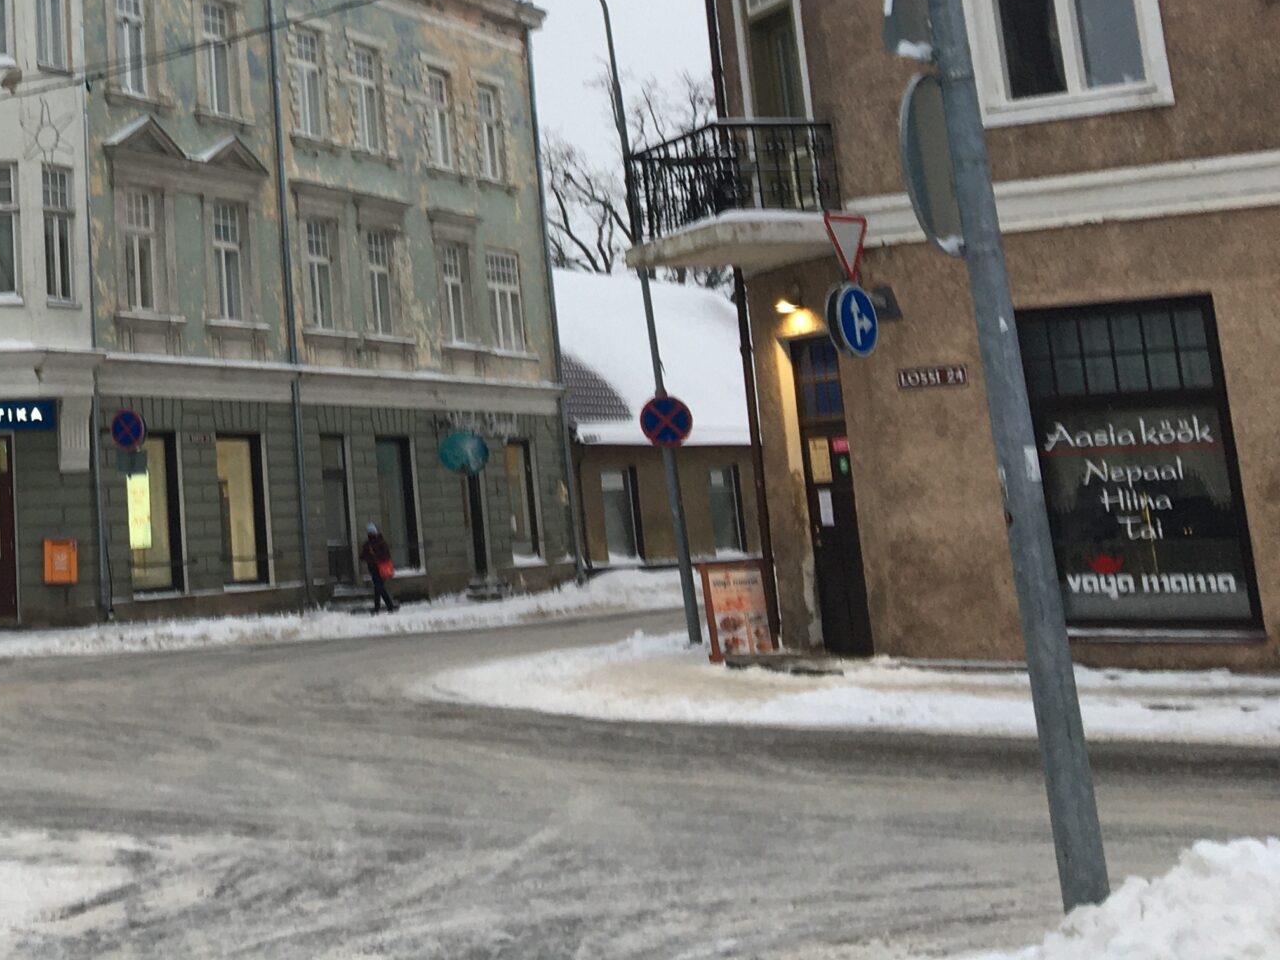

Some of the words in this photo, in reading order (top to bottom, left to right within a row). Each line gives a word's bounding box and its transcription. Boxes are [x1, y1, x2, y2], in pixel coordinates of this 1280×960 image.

[900, 368, 941, 386] LOSSI
[1043, 421, 1137, 452] Aasia
[1138, 414, 1214, 446] köök
[1082, 455, 1184, 489] Nepaal
[1100, 487, 1173, 513] Hiina
[1116, 515, 1164, 540] Tai
[1066, 572, 1136, 601] vaya
[1141, 572, 1237, 593] mama
